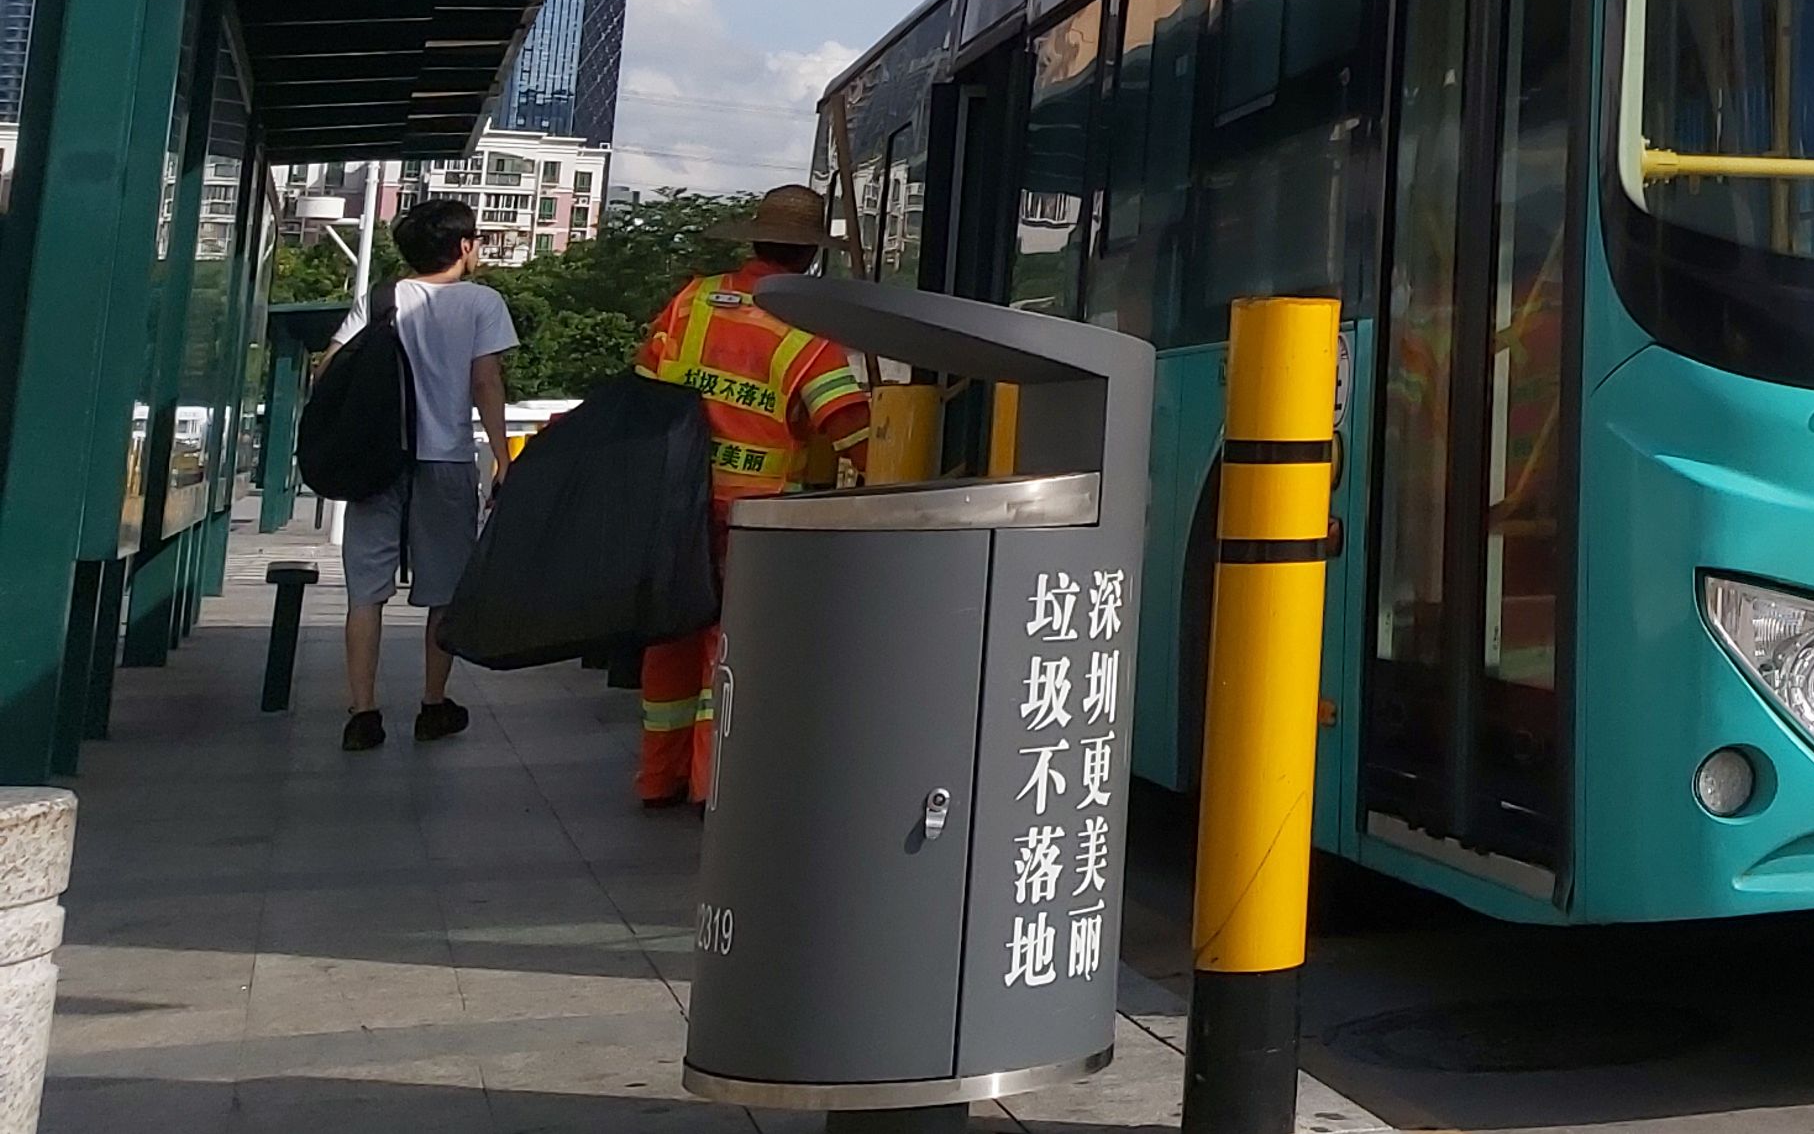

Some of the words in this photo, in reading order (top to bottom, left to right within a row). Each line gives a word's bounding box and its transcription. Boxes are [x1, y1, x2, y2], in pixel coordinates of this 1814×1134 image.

[1003, 571, 1081, 987] 垃圾不落地
[1067, 569, 1124, 981] 深圳更美丽
